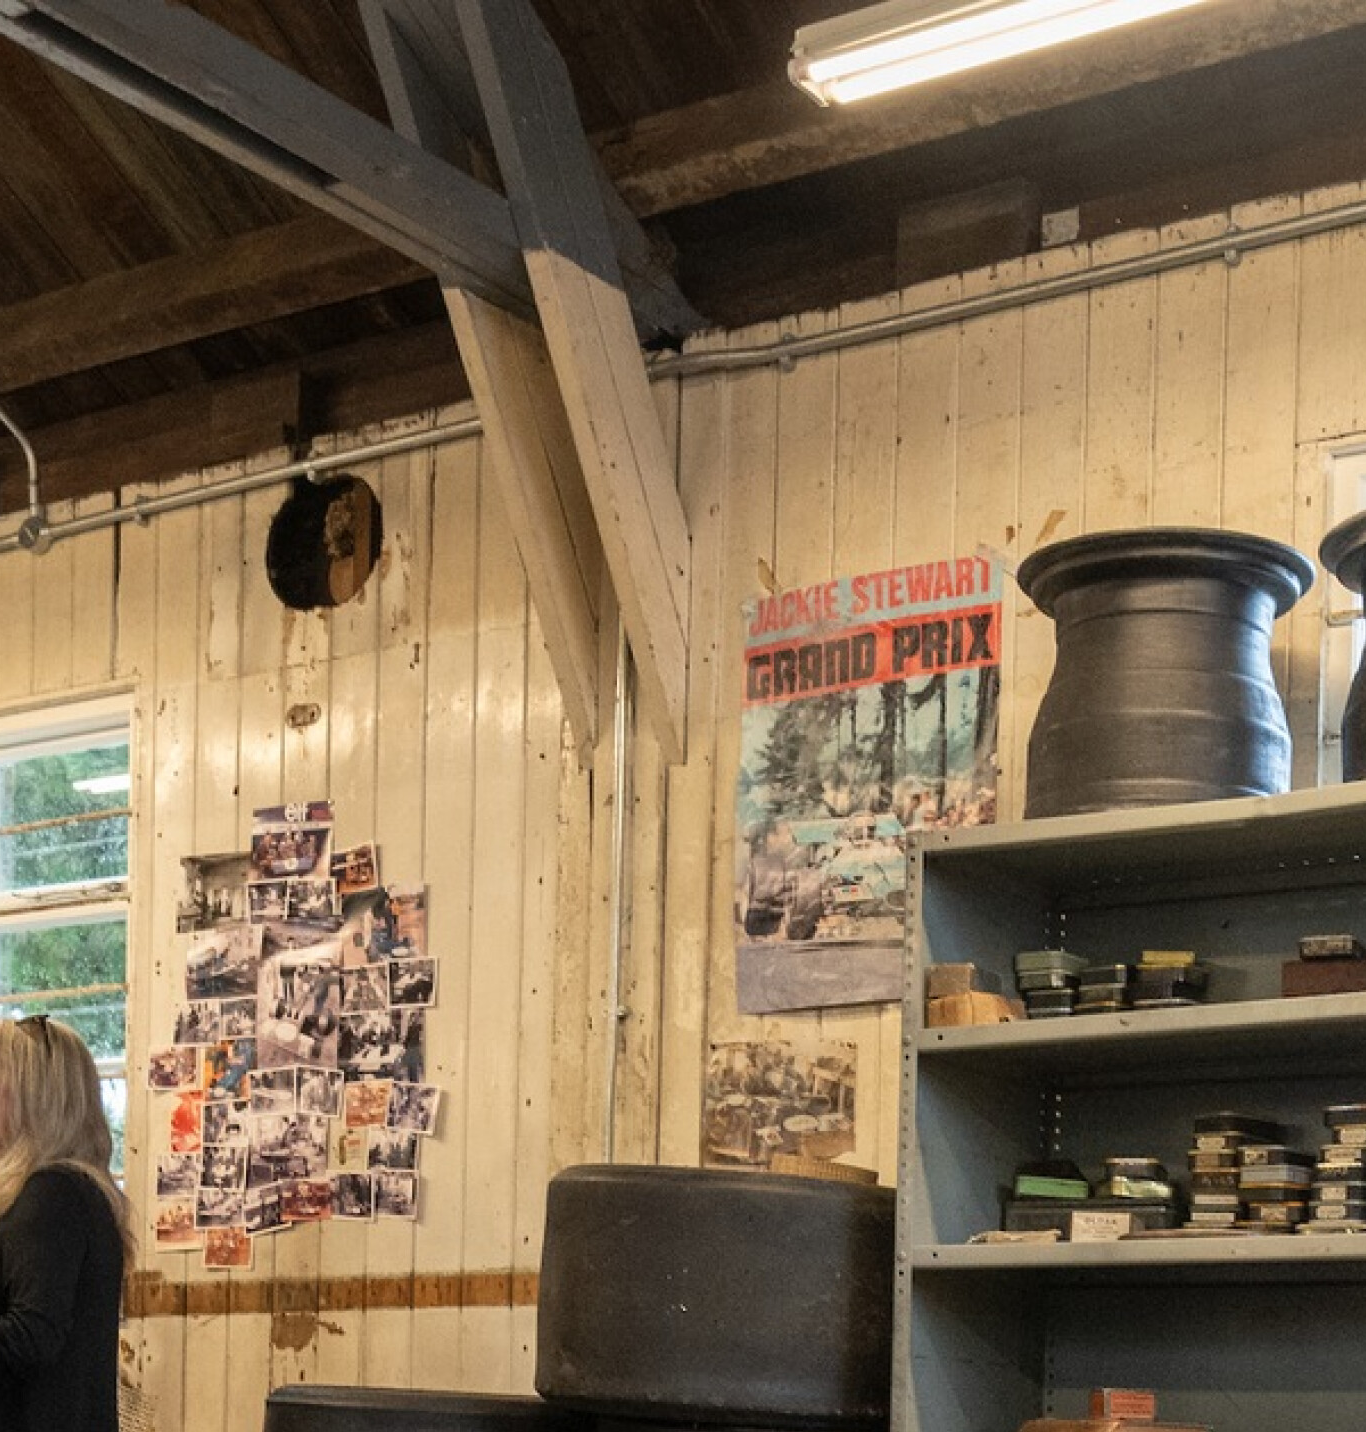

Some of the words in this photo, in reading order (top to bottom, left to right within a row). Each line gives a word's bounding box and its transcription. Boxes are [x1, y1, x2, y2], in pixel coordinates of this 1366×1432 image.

[750, 579, 840, 636] JACKIE
[851, 556, 990, 613] STEWART
[747, 632, 876, 700] GRAND
[892, 613, 993, 674] PRIX
